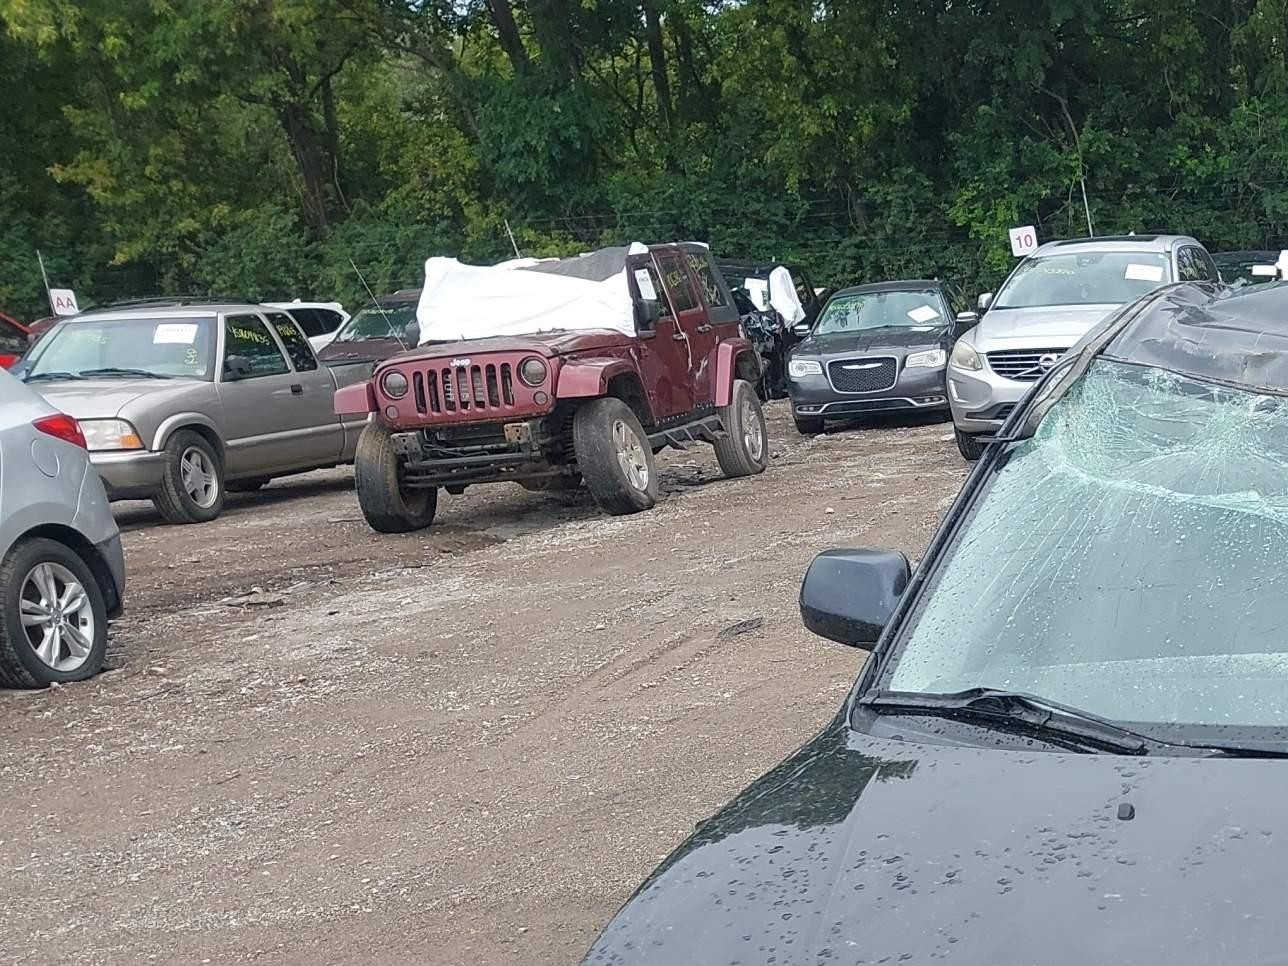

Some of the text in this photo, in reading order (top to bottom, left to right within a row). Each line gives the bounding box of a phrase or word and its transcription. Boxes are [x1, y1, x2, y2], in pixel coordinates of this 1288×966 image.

[1015, 234, 1033, 249] 10
[56, 296, 75, 309] AA
[450, 358, 471, 367] Jeep
